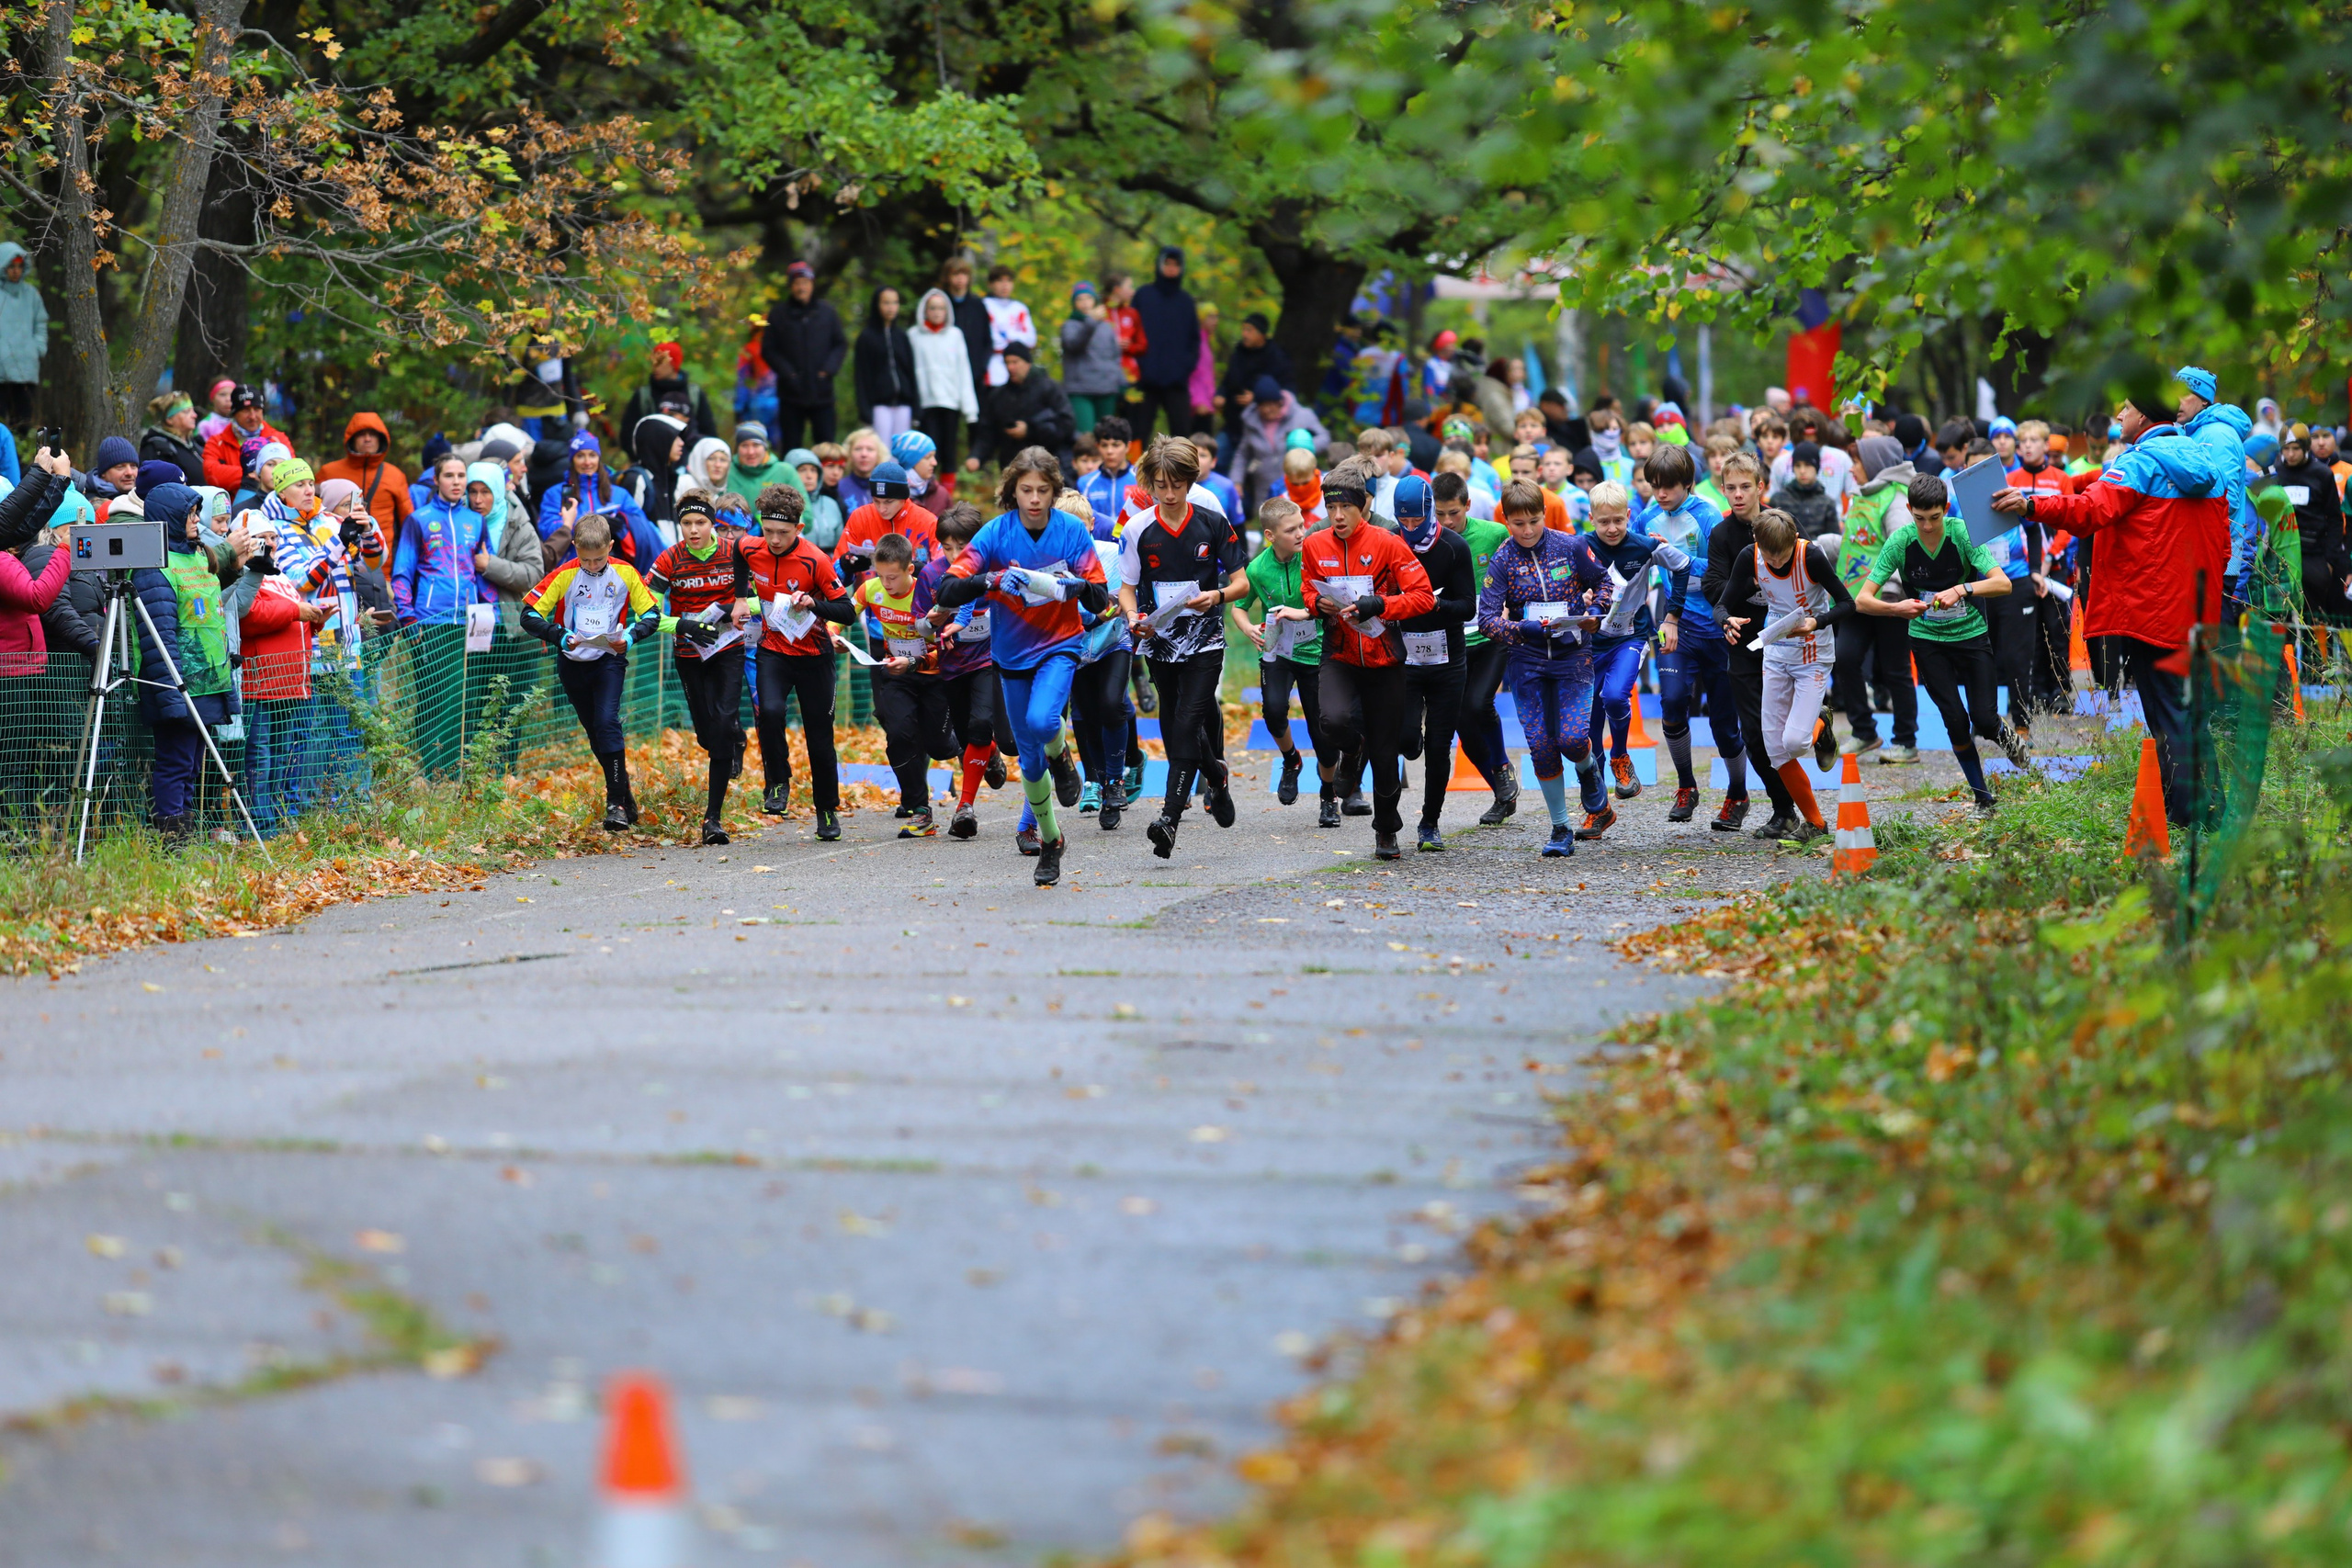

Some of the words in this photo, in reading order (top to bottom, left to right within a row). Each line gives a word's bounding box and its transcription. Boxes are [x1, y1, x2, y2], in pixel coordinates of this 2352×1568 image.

[283, 466, 312, 479] FISC
[672, 577, 704, 589] NORD
[707, 574, 735, 586] WES
[1416, 645, 1431, 653] 278
